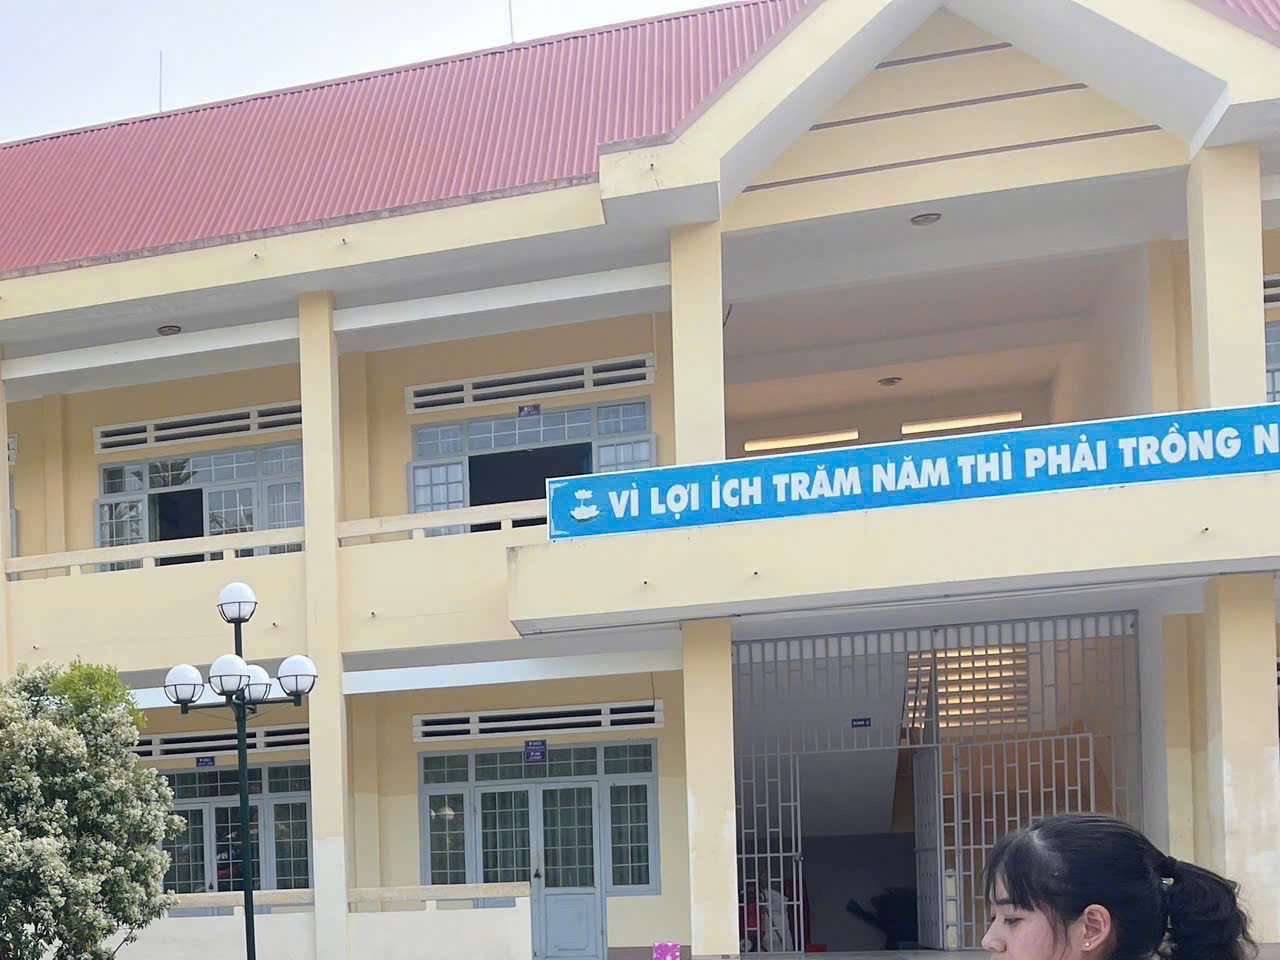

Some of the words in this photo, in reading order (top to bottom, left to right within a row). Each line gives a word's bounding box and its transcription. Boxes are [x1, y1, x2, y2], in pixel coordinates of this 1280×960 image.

[608, 482, 639, 518] VÌ
[650, 483, 700, 520] LỢI
[711, 475, 763, 509] ÍCH
[772, 466, 862, 502] TRĂM
[872, 456, 950, 493] NĂM
[957, 443, 1013, 485] THÌ
[1025, 434, 1108, 478] PHẢI
[1118, 422, 1241, 467] TRỒNG
